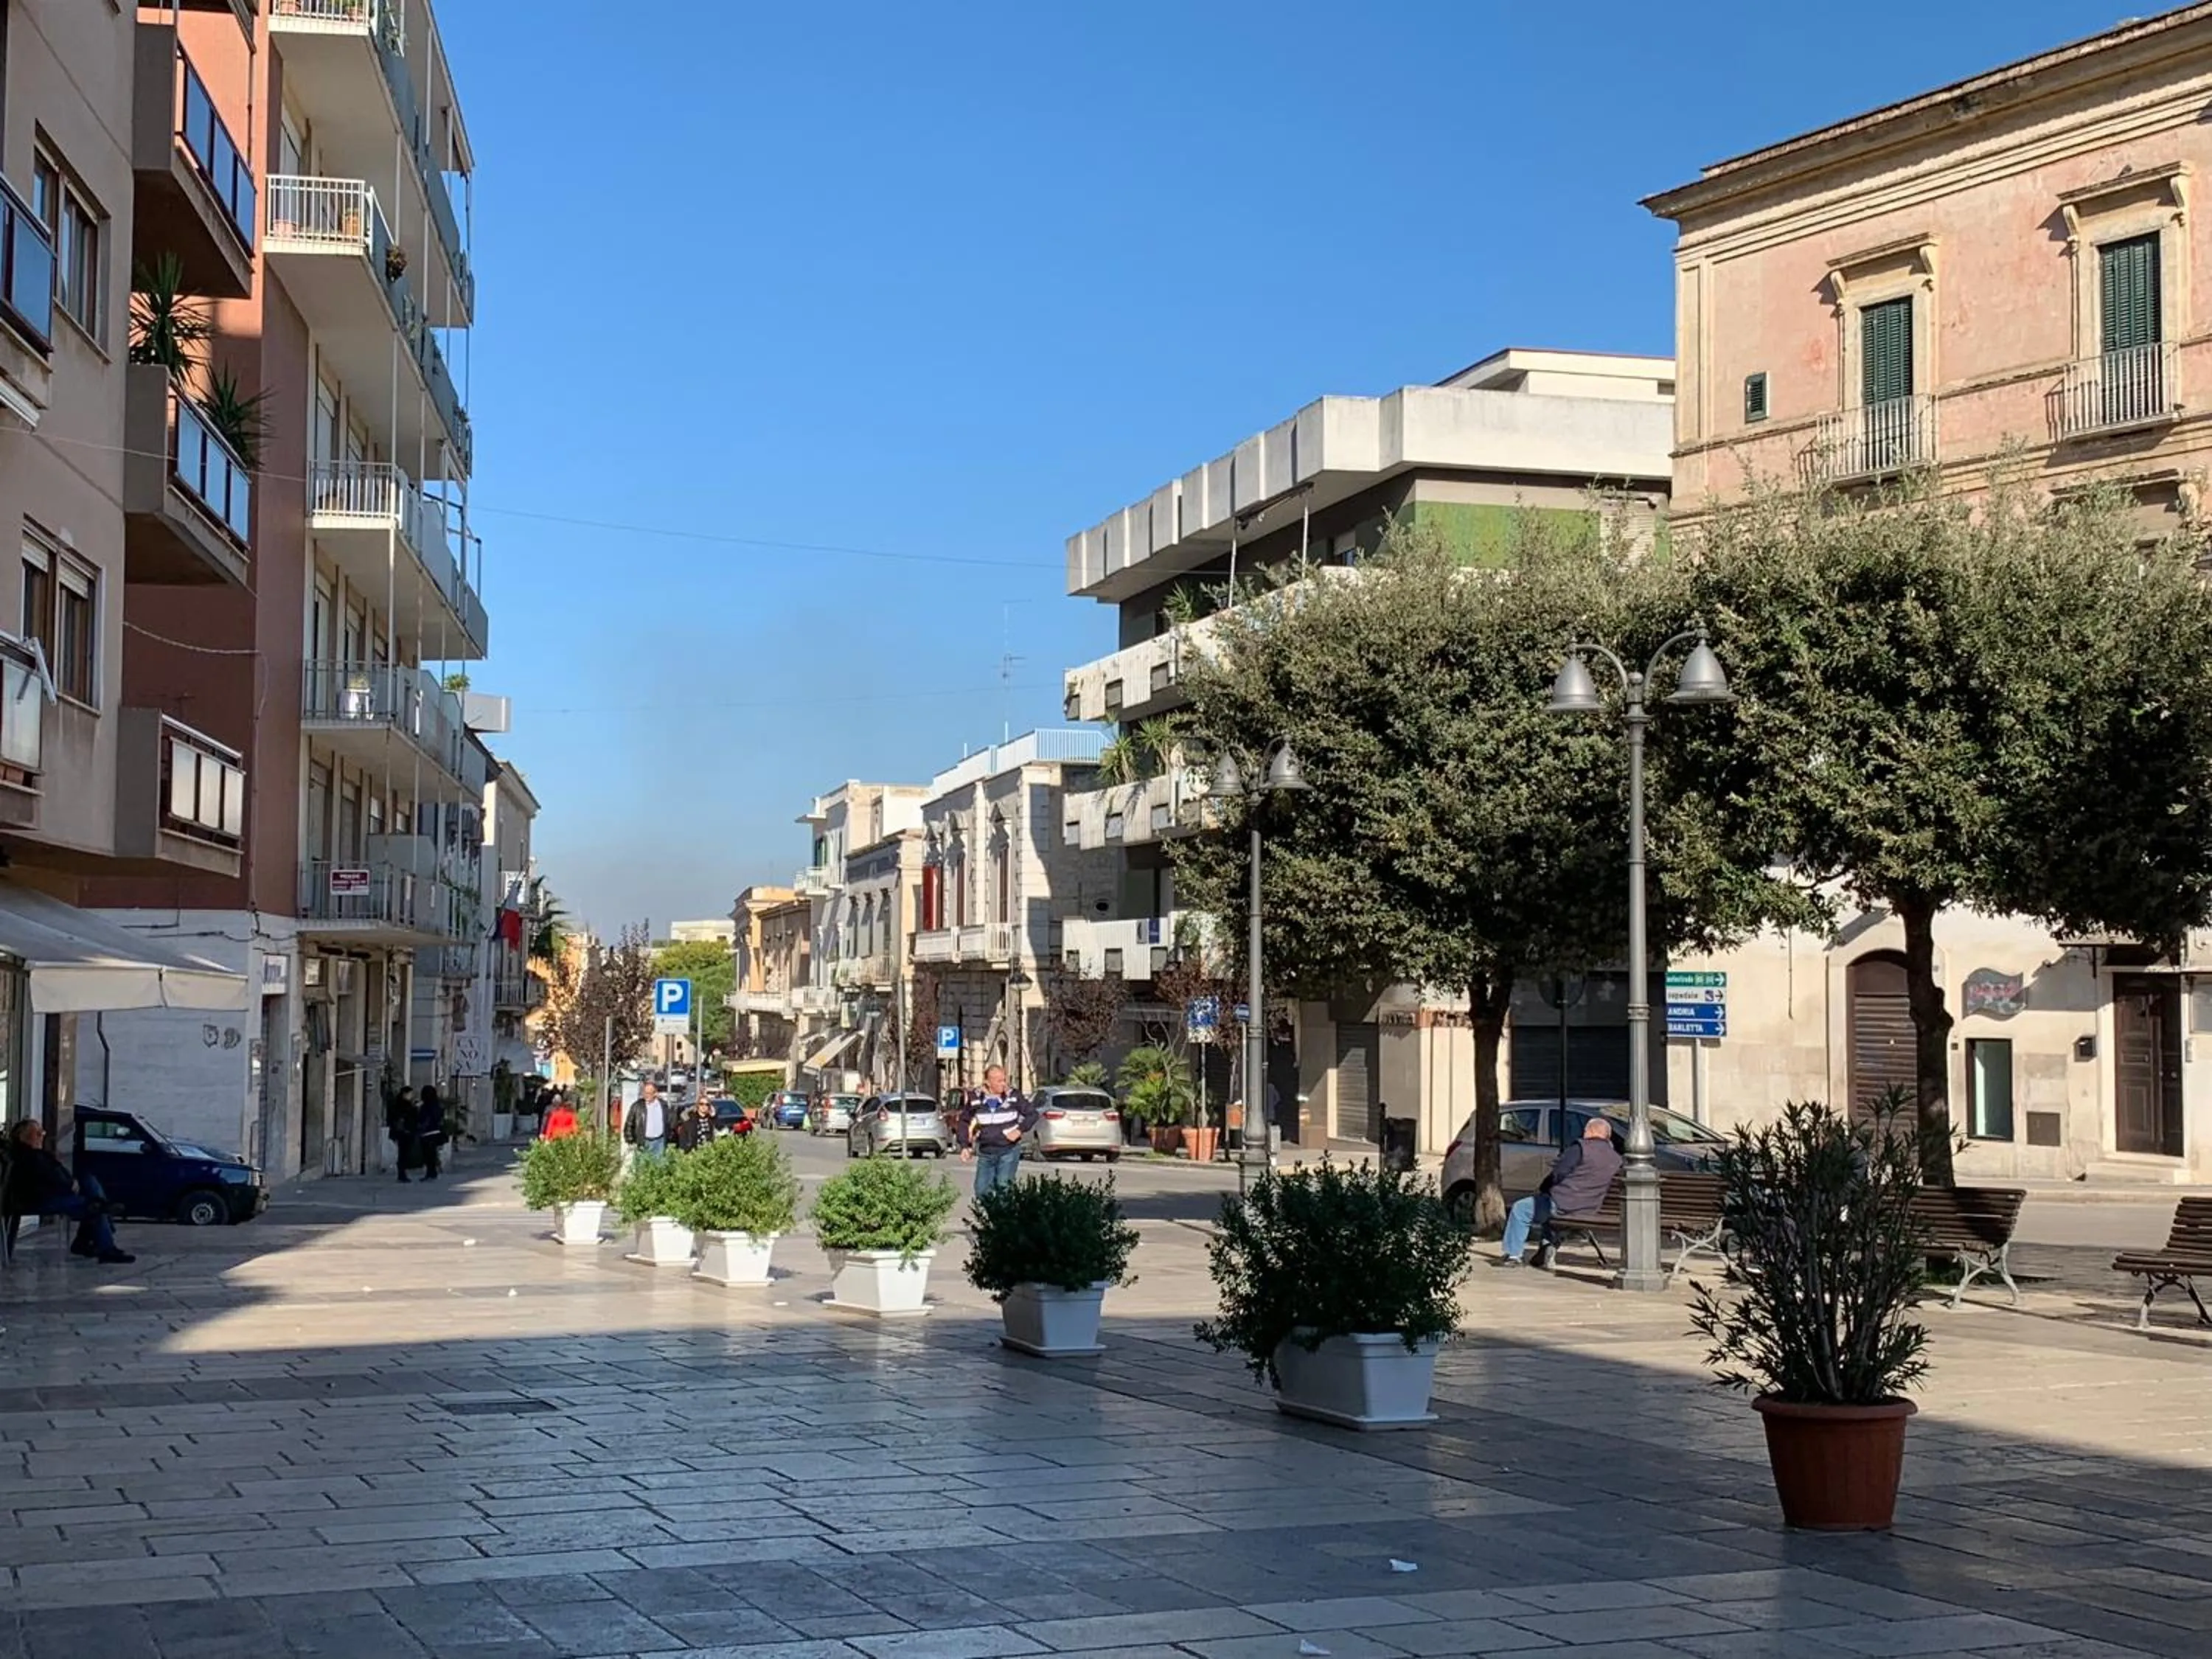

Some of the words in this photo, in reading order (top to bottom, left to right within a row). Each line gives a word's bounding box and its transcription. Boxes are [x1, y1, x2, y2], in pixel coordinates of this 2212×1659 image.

[662, 982, 684, 1012] P
[1667, 1007, 1695, 1017] ANDRIA
[1668, 1023, 1704, 1033] BARLETTA
[942, 1029, 954, 1046] P
